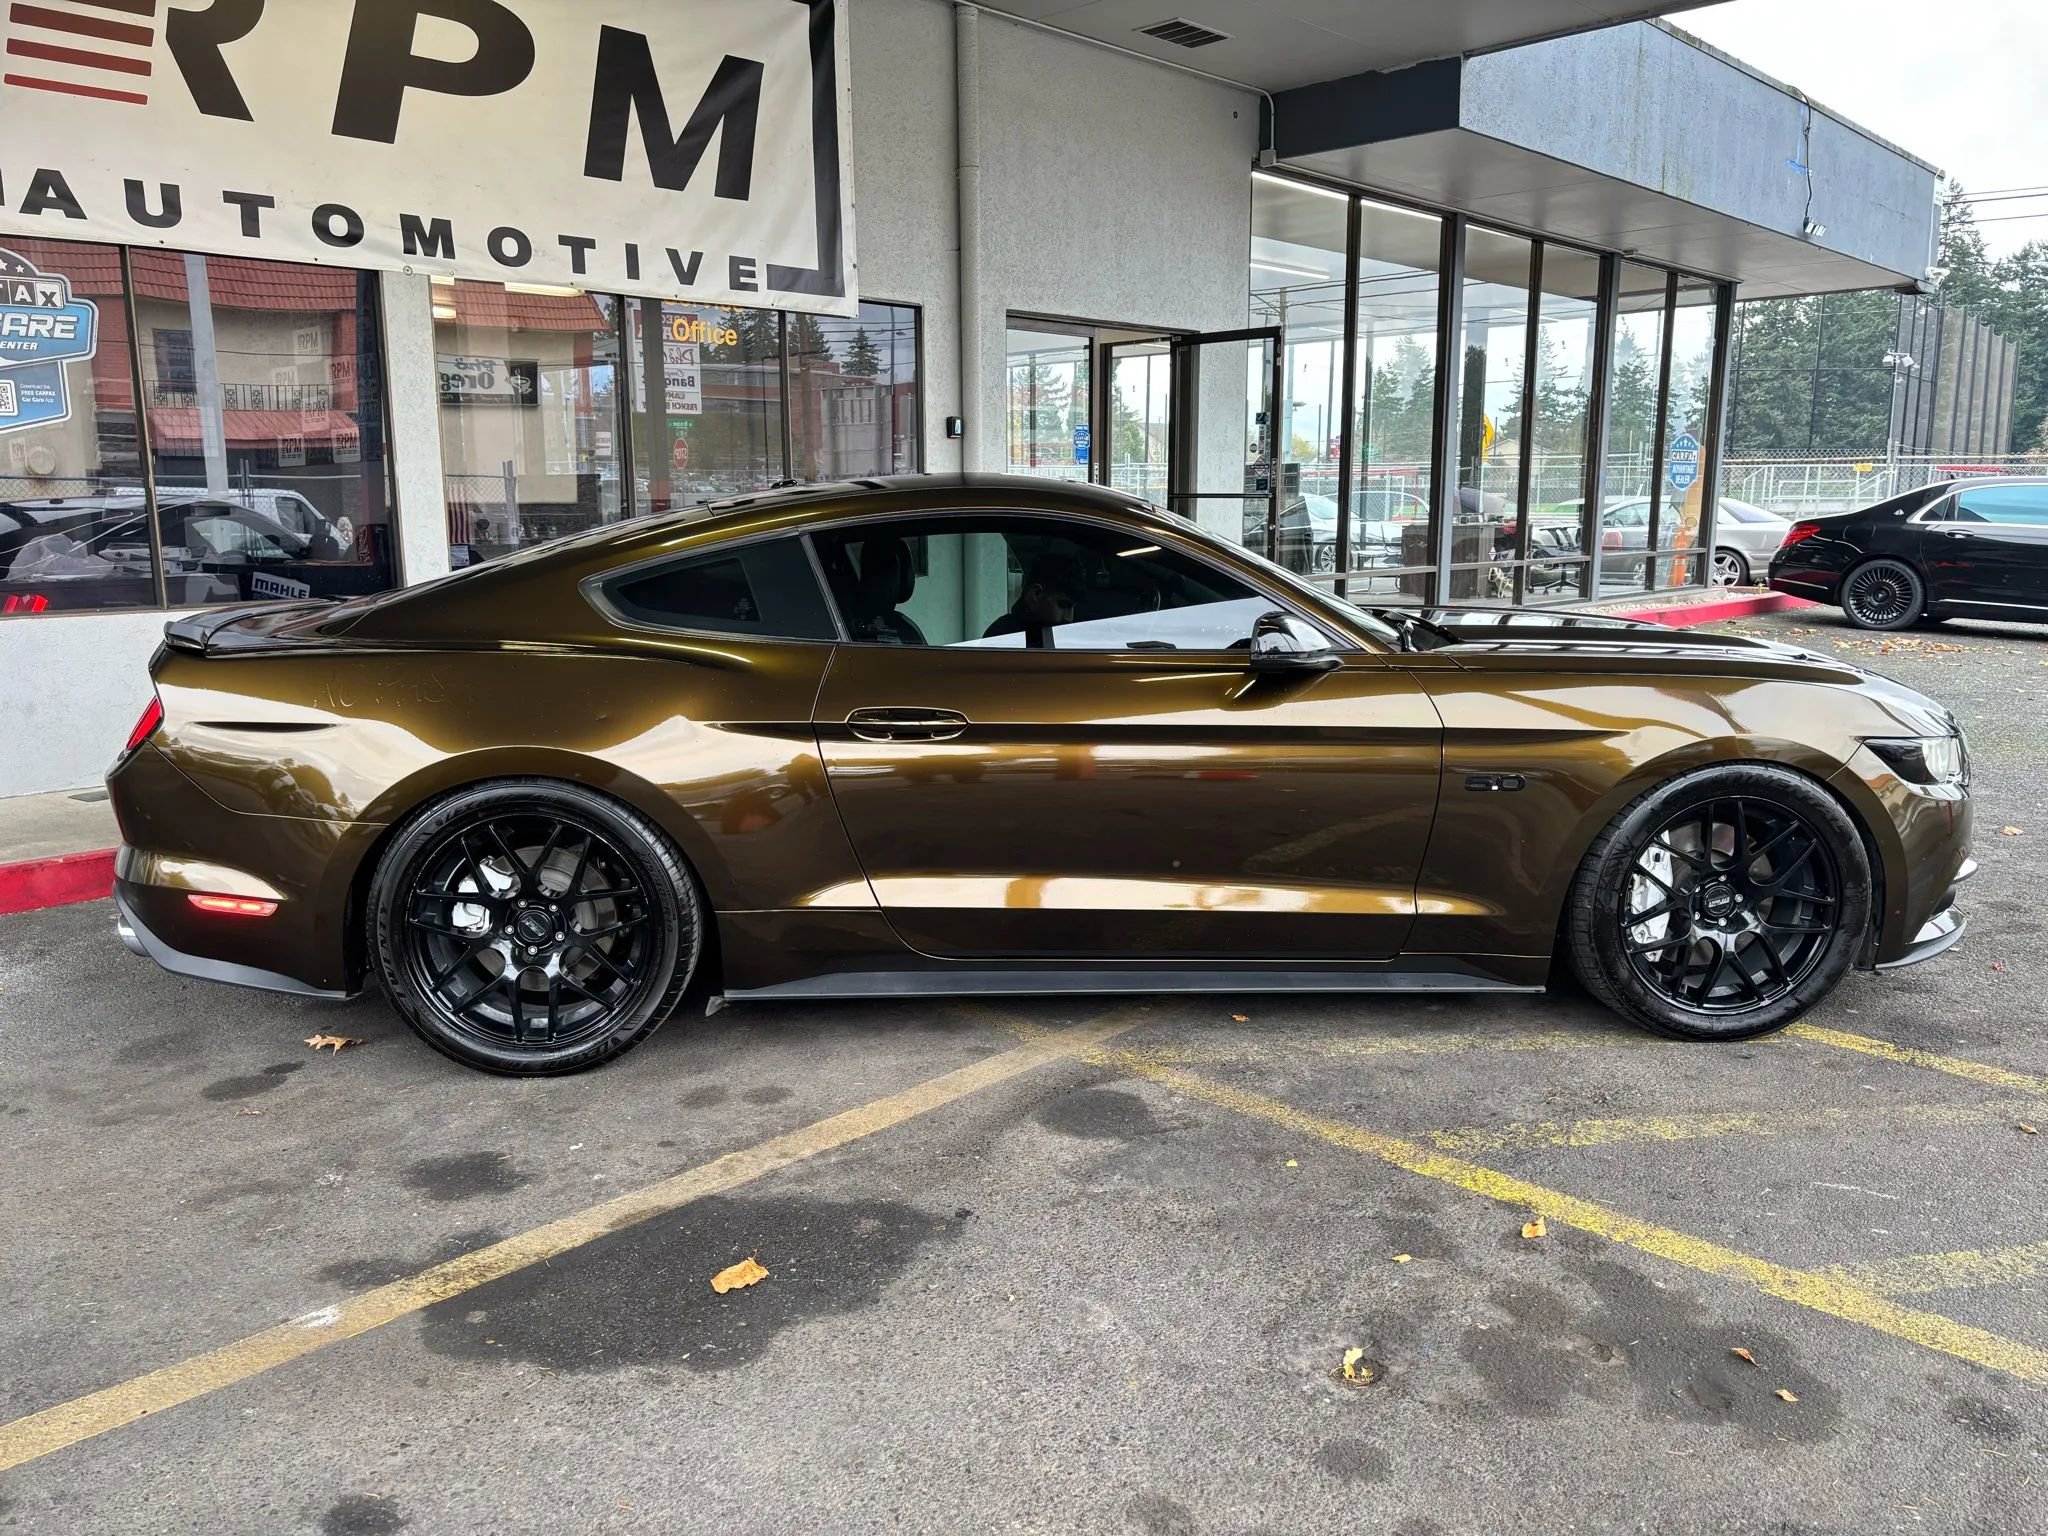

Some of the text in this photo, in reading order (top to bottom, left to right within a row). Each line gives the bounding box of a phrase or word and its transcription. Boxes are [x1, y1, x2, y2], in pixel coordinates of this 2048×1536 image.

[166, 0, 764, 201] RPM
[19, 168, 759, 293] AUTOMOTIVE
[0, 283, 59, 307] AX
[0, 312, 78, 339] ARE
[672, 318, 738, 346] Office
[0, 341, 38, 350] ENTER
[254, 578, 308, 600] MAHLE
